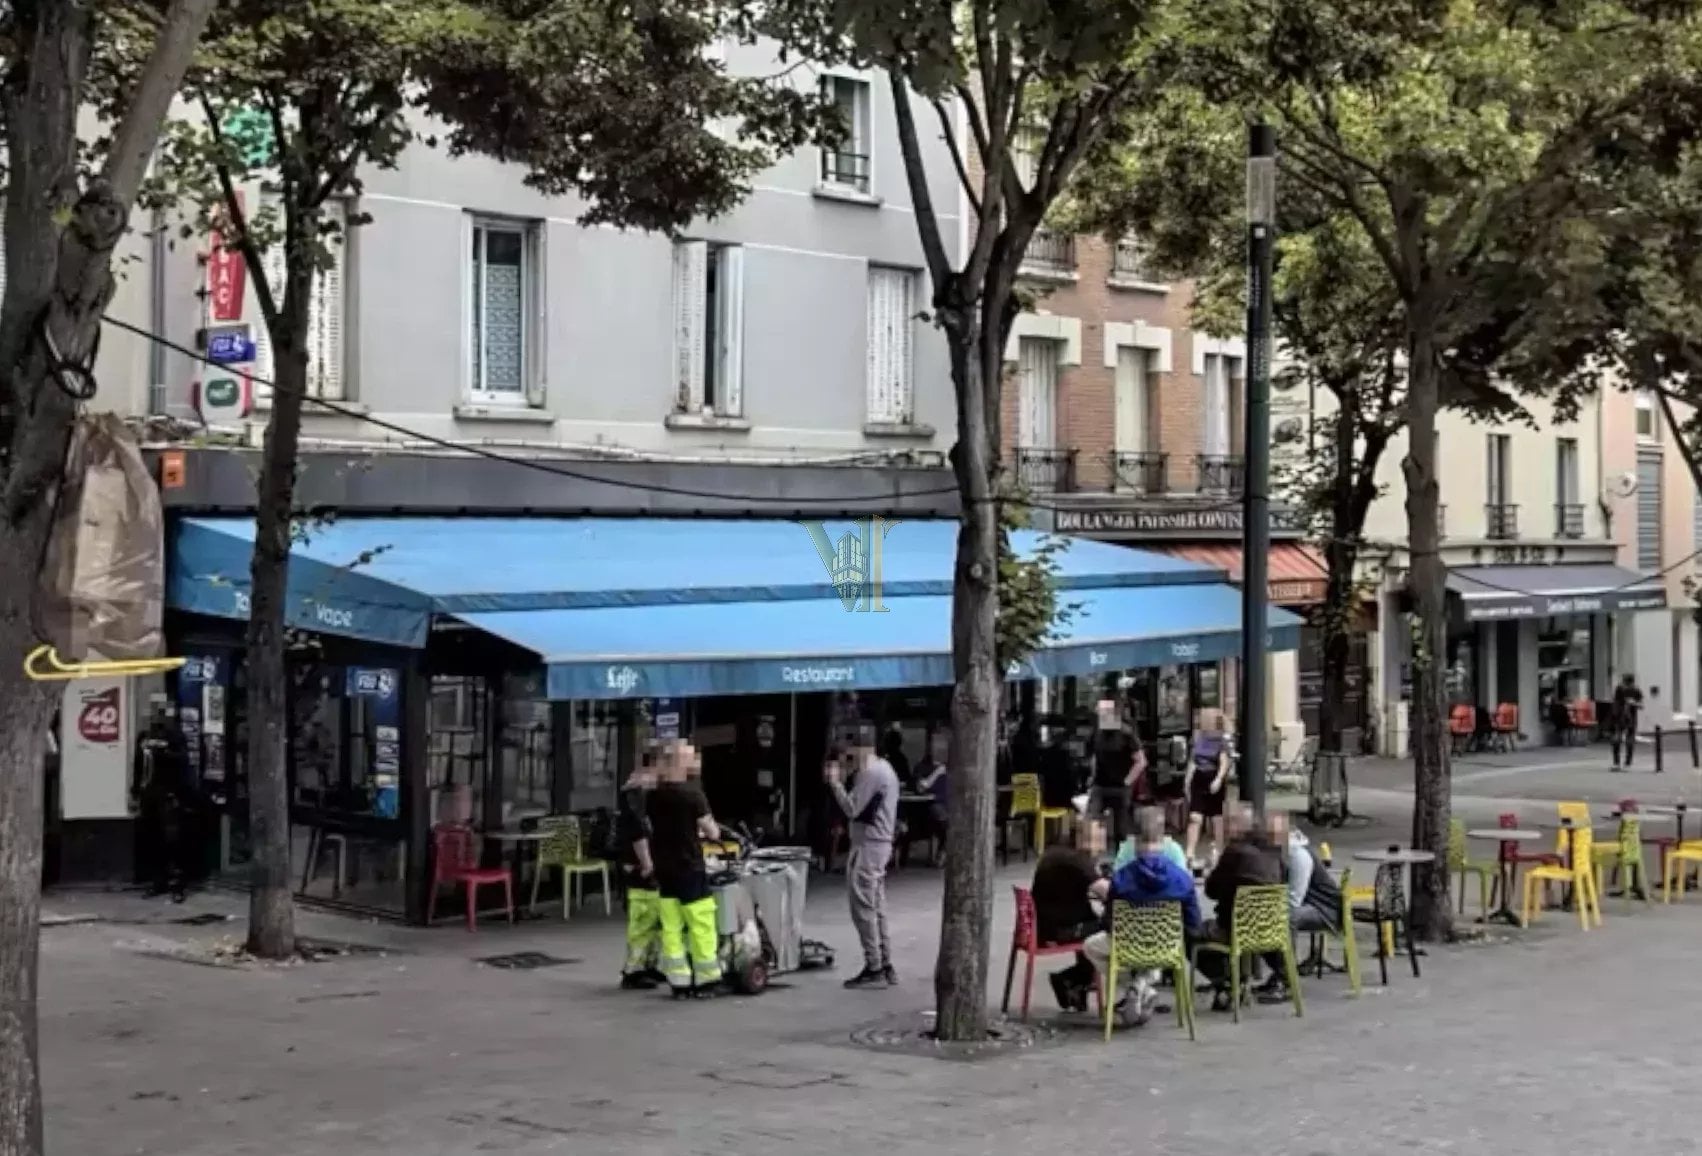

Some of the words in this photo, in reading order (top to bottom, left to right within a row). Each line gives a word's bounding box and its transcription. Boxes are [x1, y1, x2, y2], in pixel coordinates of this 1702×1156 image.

[316, 603, 353, 627] Vape
[781, 666, 855, 683] Restaurant
[85, 706, 118, 725] 40
